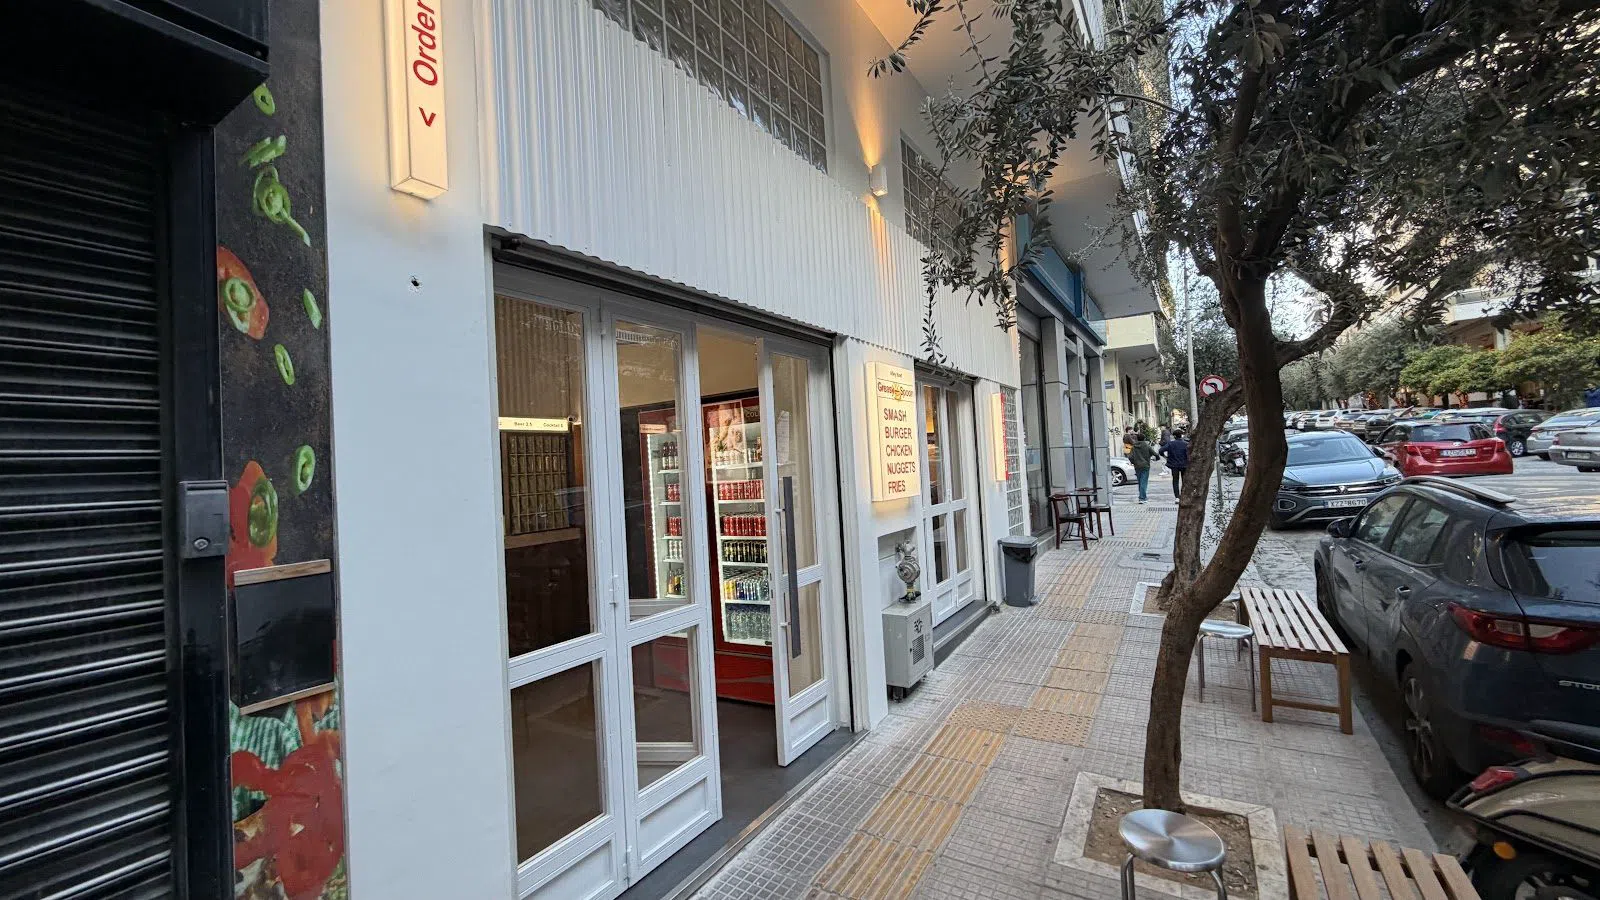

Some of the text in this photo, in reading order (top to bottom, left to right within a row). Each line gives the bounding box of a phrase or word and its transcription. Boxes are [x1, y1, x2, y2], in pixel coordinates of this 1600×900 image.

[411, 0, 438, 86] Order
[883, 407, 907, 422] SMASH
[884, 426, 913, 440] BURGER
[885, 444, 913, 457] CHICKEN
[887, 461, 916, 475] NUGGETS
[888, 479, 906, 494] FRIES
